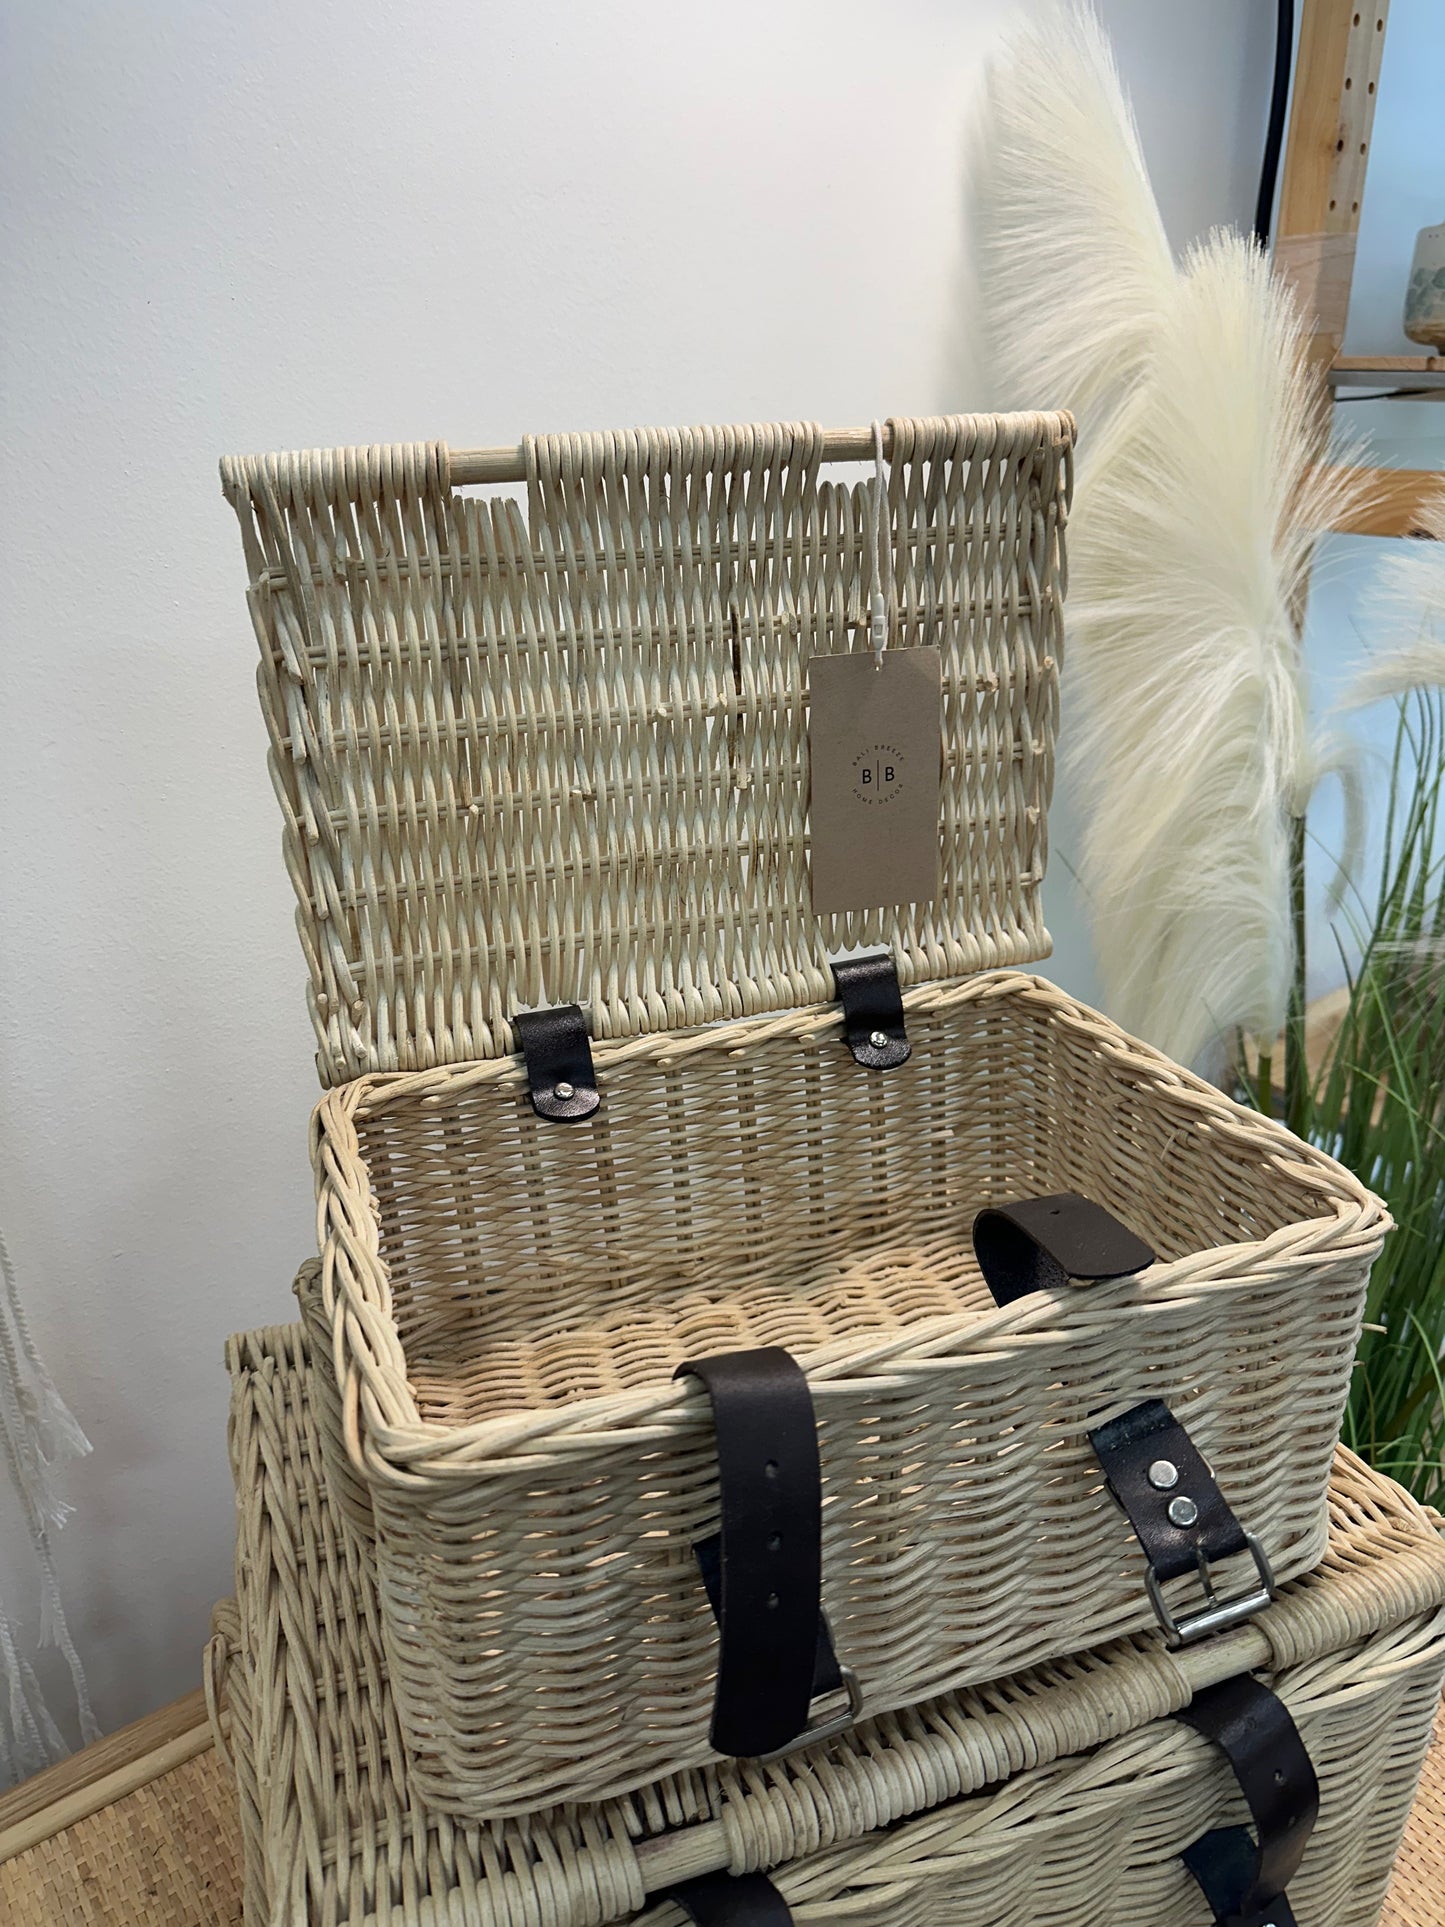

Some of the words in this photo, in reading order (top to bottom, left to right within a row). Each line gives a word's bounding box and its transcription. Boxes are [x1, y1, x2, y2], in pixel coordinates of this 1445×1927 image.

[862, 769, 872, 784] B
[885, 766, 895, 782] B
[852, 788, 872, 805] HOME
[878, 783, 904, 805] DECOR
